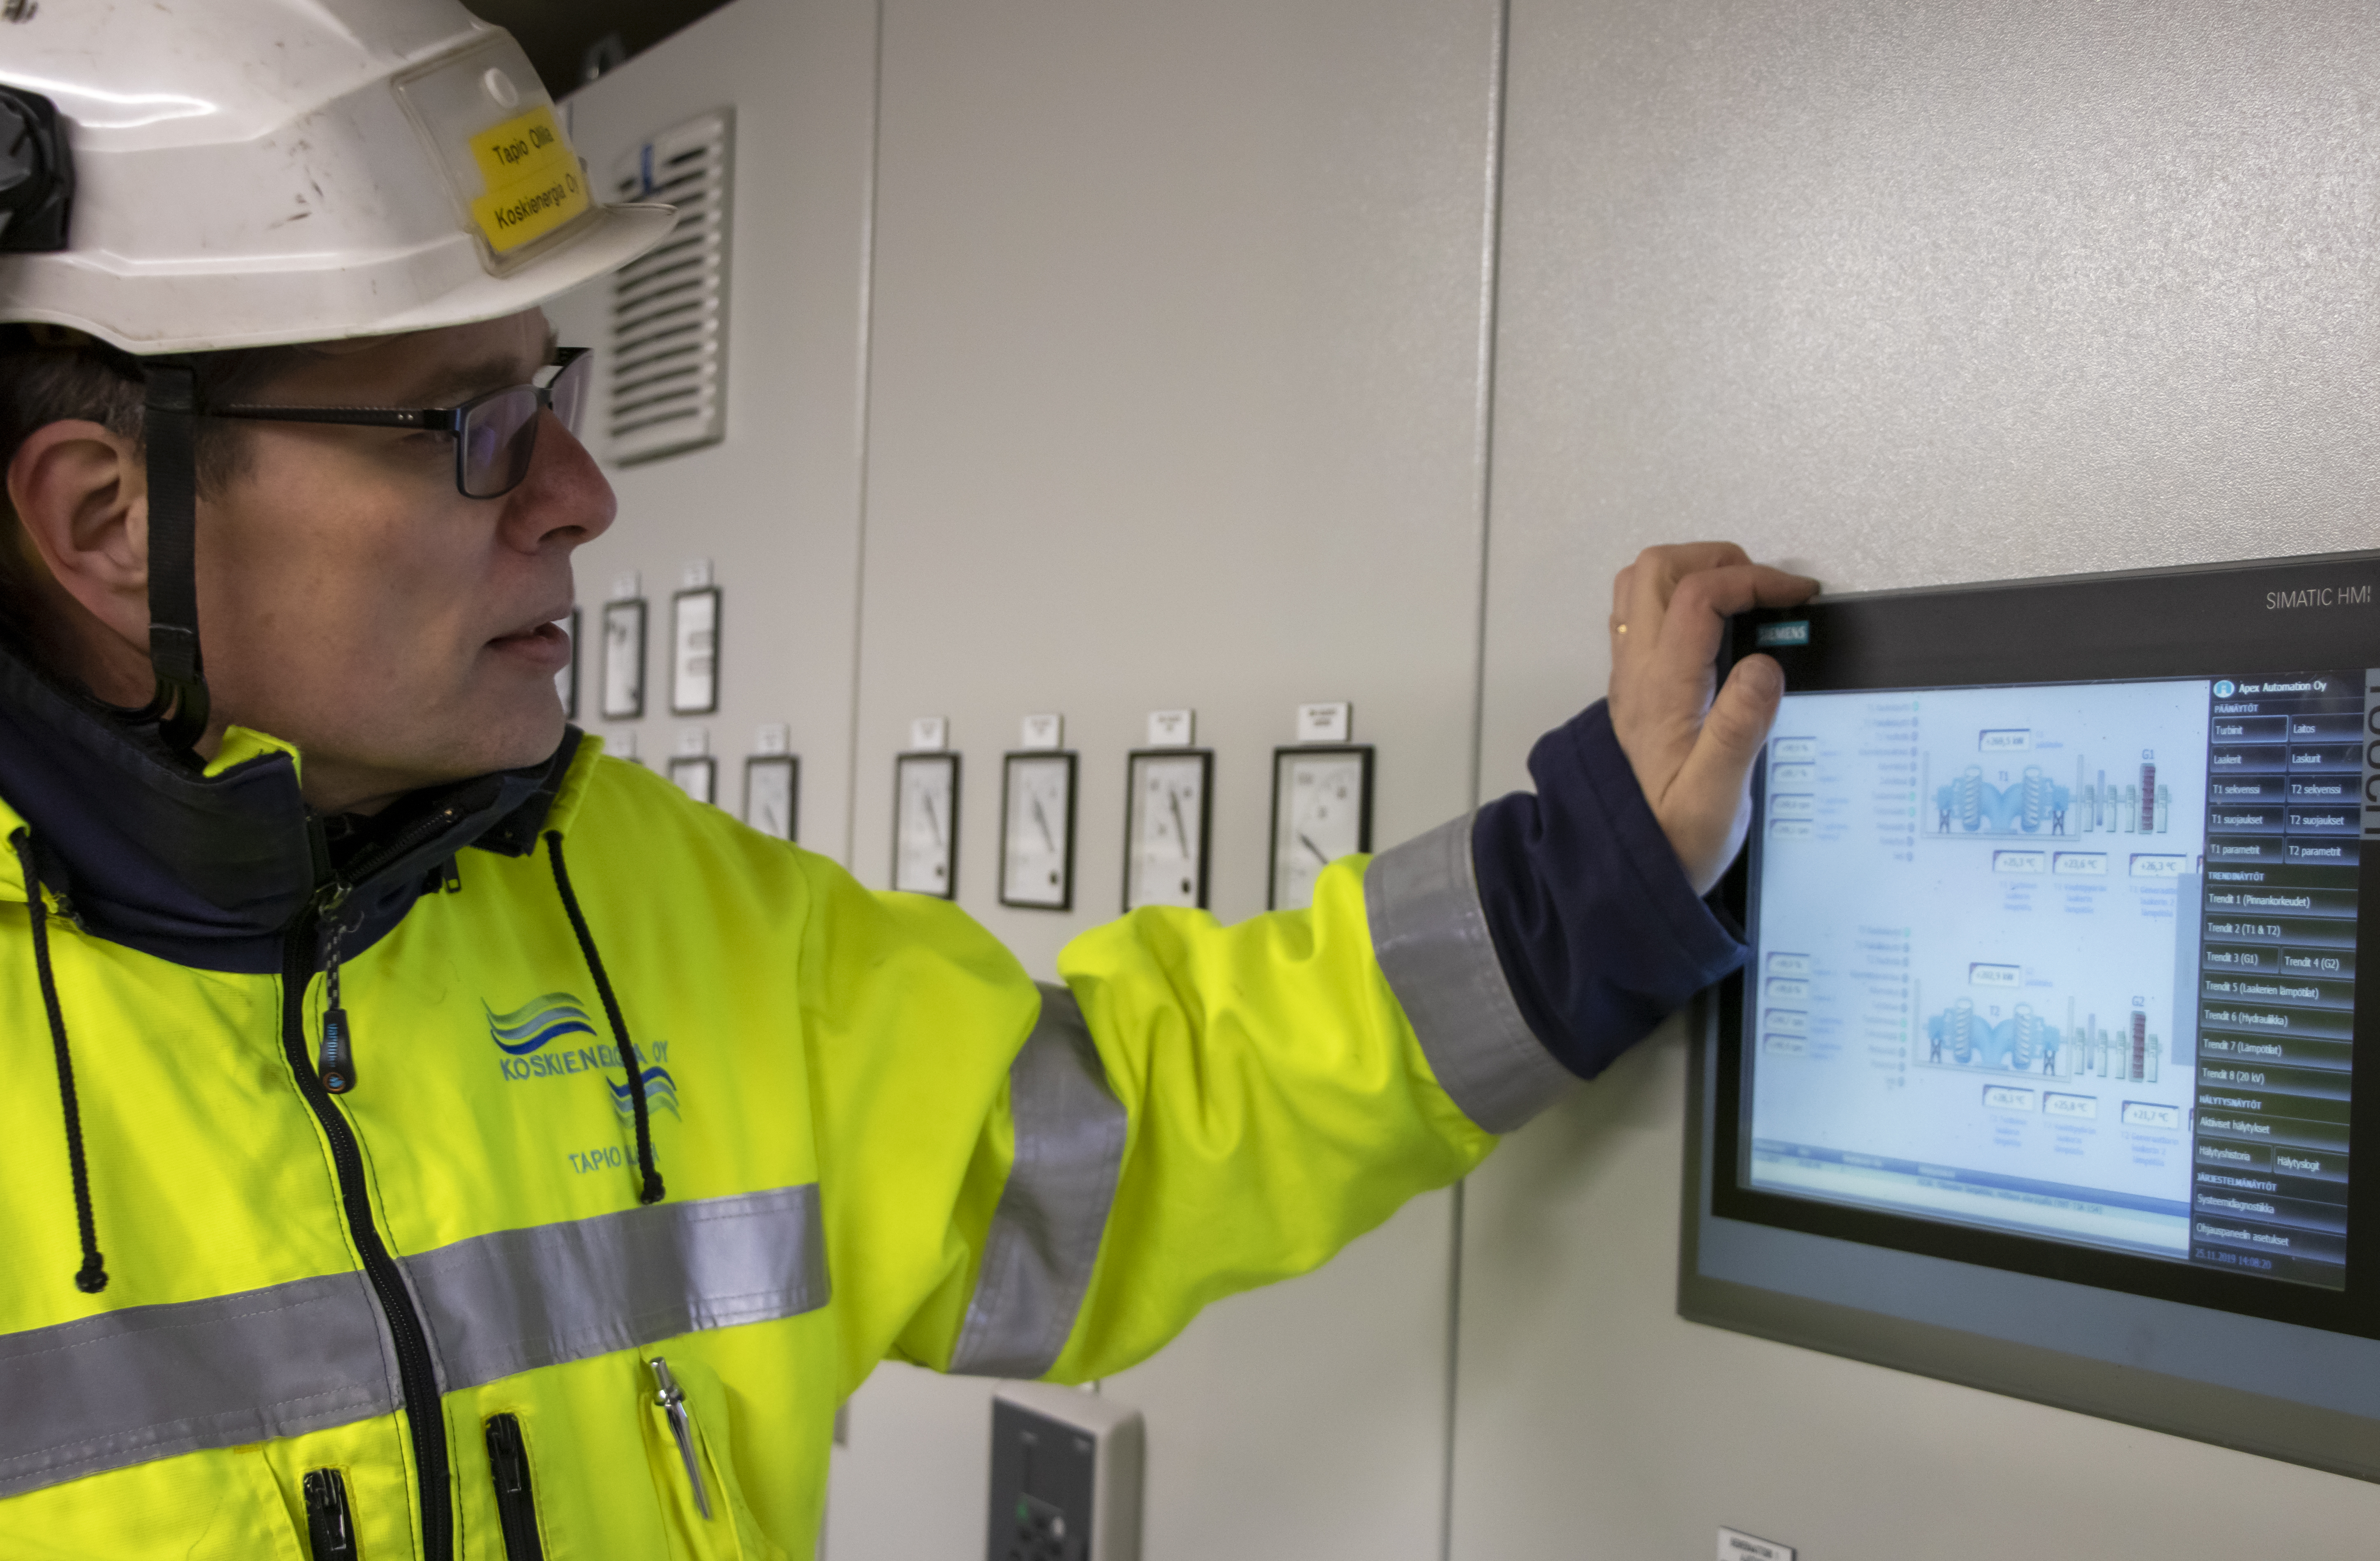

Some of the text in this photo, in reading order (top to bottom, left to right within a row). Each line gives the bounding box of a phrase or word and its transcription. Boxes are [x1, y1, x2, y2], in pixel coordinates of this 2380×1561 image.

[492, 138, 529, 165] Tapio
[2266, 587, 2332, 610] SIMATIC
[2239, 680, 2327, 695] Apex Automation Oy
[2293, 723, 2315, 734] Laitos
[2142, 749, 2155, 760] G1
[2292, 753, 2321, 763] Laskurit
[1998, 771, 2009, 782] T1
[2213, 784, 2260, 794] T1 sekvenssi
[2292, 784, 2342, 794] T2 sekvenssi
[2212, 814, 2263, 826] T1 suojaukset
[2290, 815, 2344, 827] T2 suojaukset
[2211, 844, 2220, 854] T1
[2289, 846, 2341, 857] T2 parametrit
[2236, 895, 2240, 904] 1
[2235, 924, 2240, 933] 2
[2242, 923, 2255, 936] (T1
[2258, 925, 2264, 935] &
[2267, 925, 2281, 937] T2)
[2234, 953, 2239, 962] 3
[2241, 953, 2258, 966] (G1)
[2313, 958, 2319, 967] 4
[2321, 958, 2340, 971] (G2)
[2232, 982, 2238, 992] 5
[2132, 996, 2145, 1007] G2
[1990, 1005, 2000, 1017] T2
[2231, 1012, 2237, 1021] 6
[2230, 1041, 2236, 1050] 7
[500, 1040, 668, 1082] KOSKIENEA OY
[2229, 1071, 2235, 1080] 8
[2237, 1071, 2249, 1083] (20
[2251, 1072, 2265, 1085] kV)
[568, 1146, 621, 1174] TAPIO
